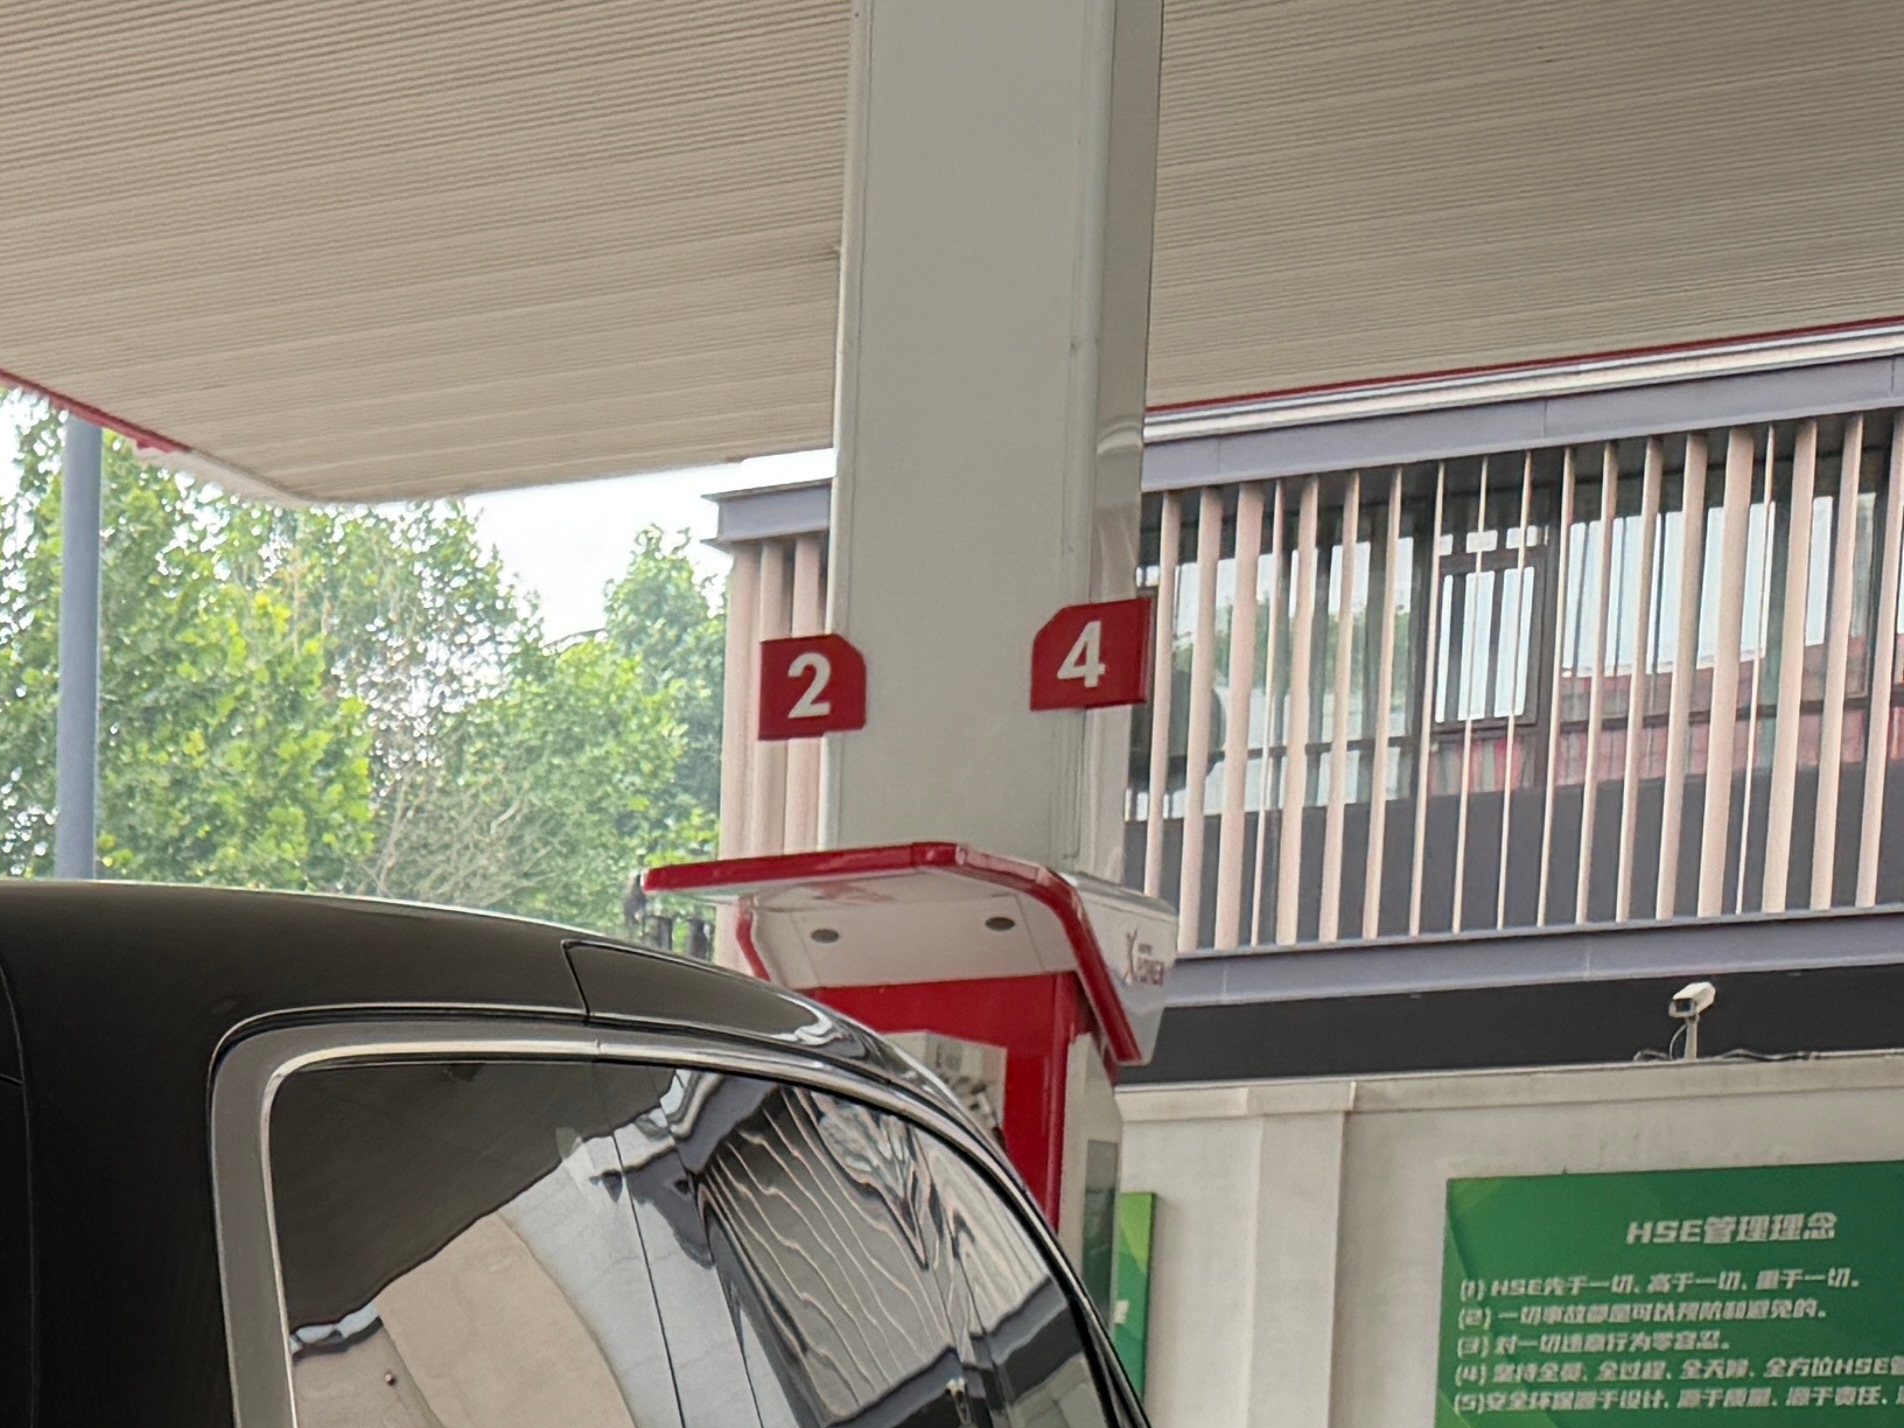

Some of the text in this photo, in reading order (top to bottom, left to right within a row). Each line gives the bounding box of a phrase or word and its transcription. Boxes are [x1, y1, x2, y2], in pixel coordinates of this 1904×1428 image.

[786, 651, 832, 719] 2
[1057, 620, 1106, 688] 4
[1625, 1211, 1838, 1246] HSE管理理念
